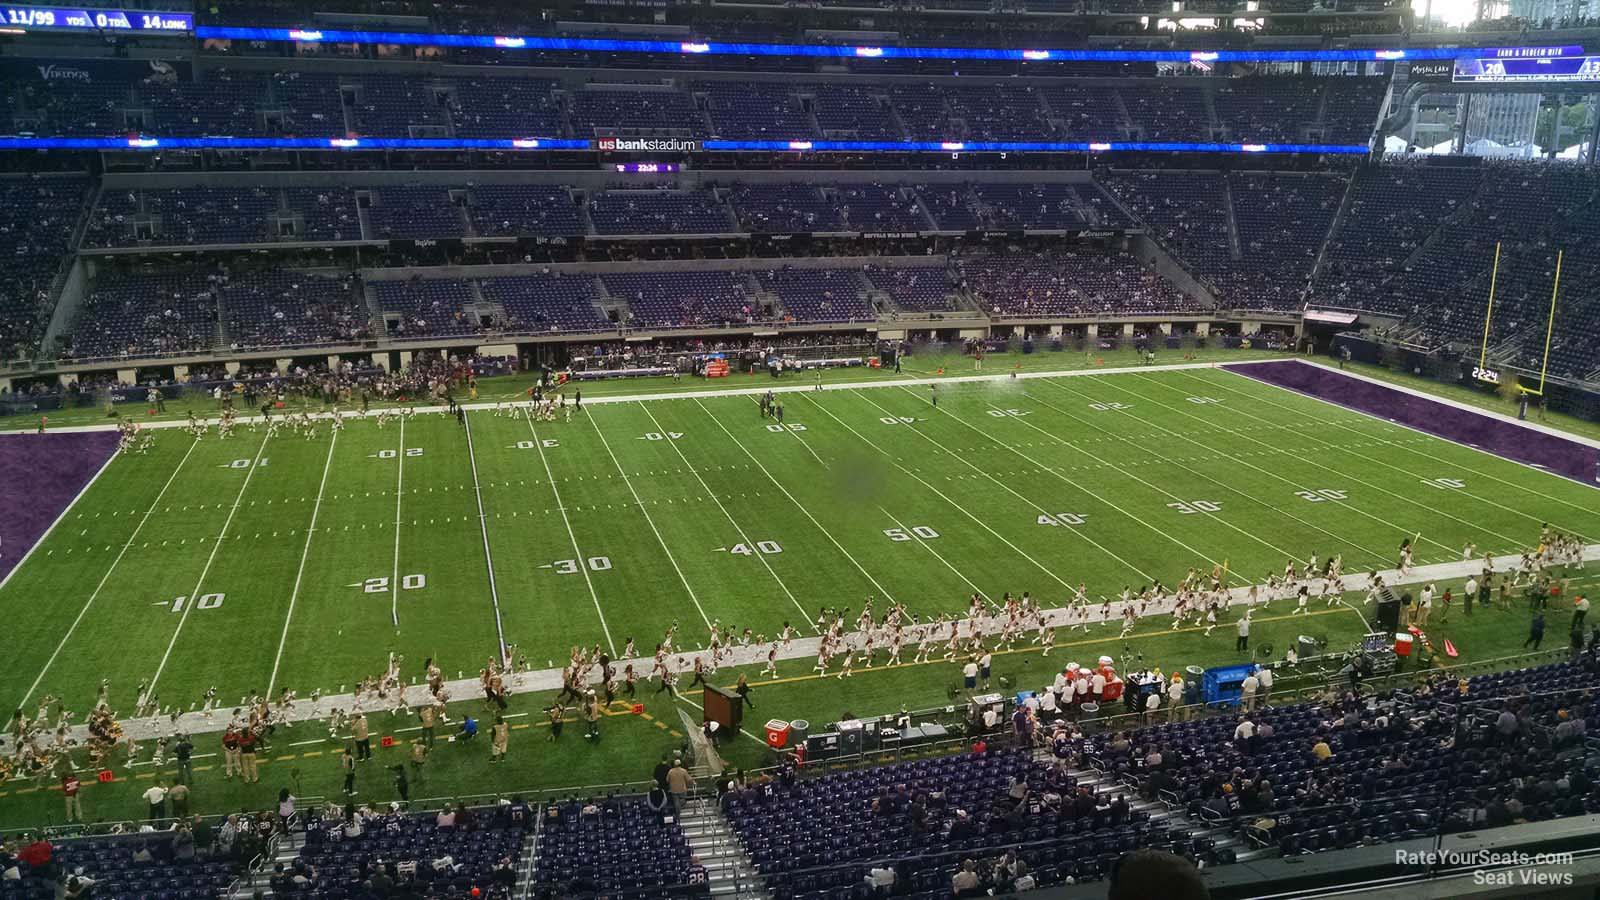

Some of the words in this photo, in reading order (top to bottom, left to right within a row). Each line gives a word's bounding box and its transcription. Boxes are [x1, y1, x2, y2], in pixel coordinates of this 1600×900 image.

[8, 10, 55, 25] 11/99
[96, 15, 106, 26] 0
[143, 16, 161, 28] 14
[162, 19, 187, 29] LONG
[1485, 63, 1500, 74] 20
[1420, 477, 1465, 490] 10
[1294, 488, 1345, 503] 20
[1166, 500, 1220, 514] 30
[1037, 512, 1085, 528] 40
[883, 525, 942, 542] 50
[729, 539, 784, 557] 40
[552, 556, 613, 575] 30
[363, 574, 426, 593] 20
[171, 593, 226, 613] 10
[769, 732, 778, 742] G
